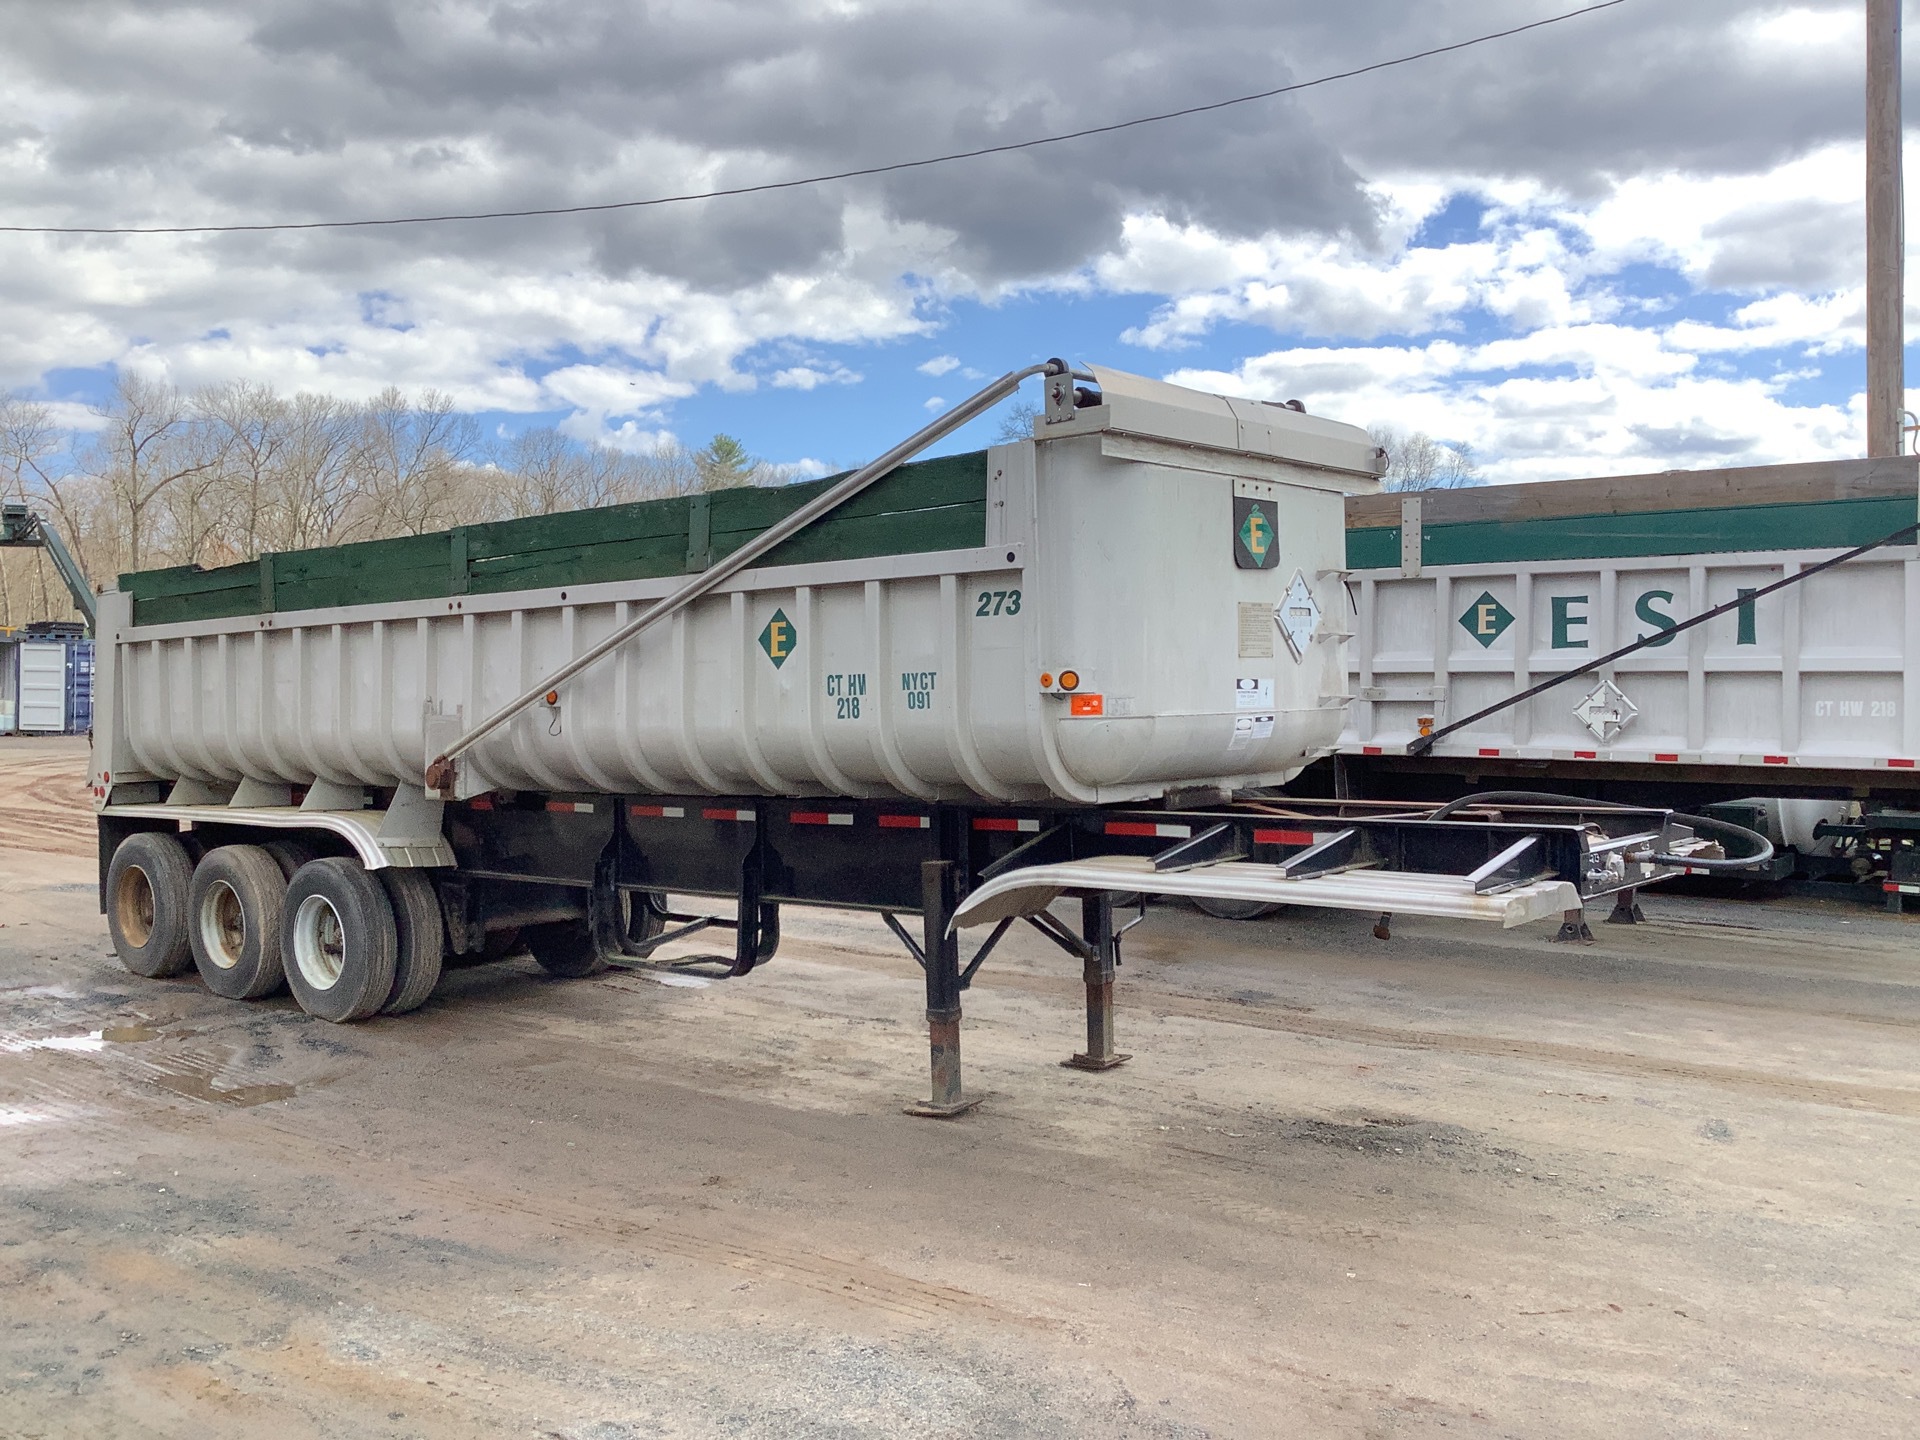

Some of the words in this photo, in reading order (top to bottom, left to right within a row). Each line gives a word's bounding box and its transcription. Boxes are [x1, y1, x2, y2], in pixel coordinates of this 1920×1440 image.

[1250, 517, 1265, 553] E
[976, 590, 1022, 617] 273
[1477, 603, 1497, 635] E
[770, 621, 787, 658] E
[827, 674, 843, 696] CT
[902, 672, 937, 691] NYCT
[837, 697, 860, 719] 218
[908, 691, 931, 710] 091
[1815, 700, 1833, 717] CT
[1839, 700, 1863, 717] HW
[1871, 700, 1896, 717] 218
